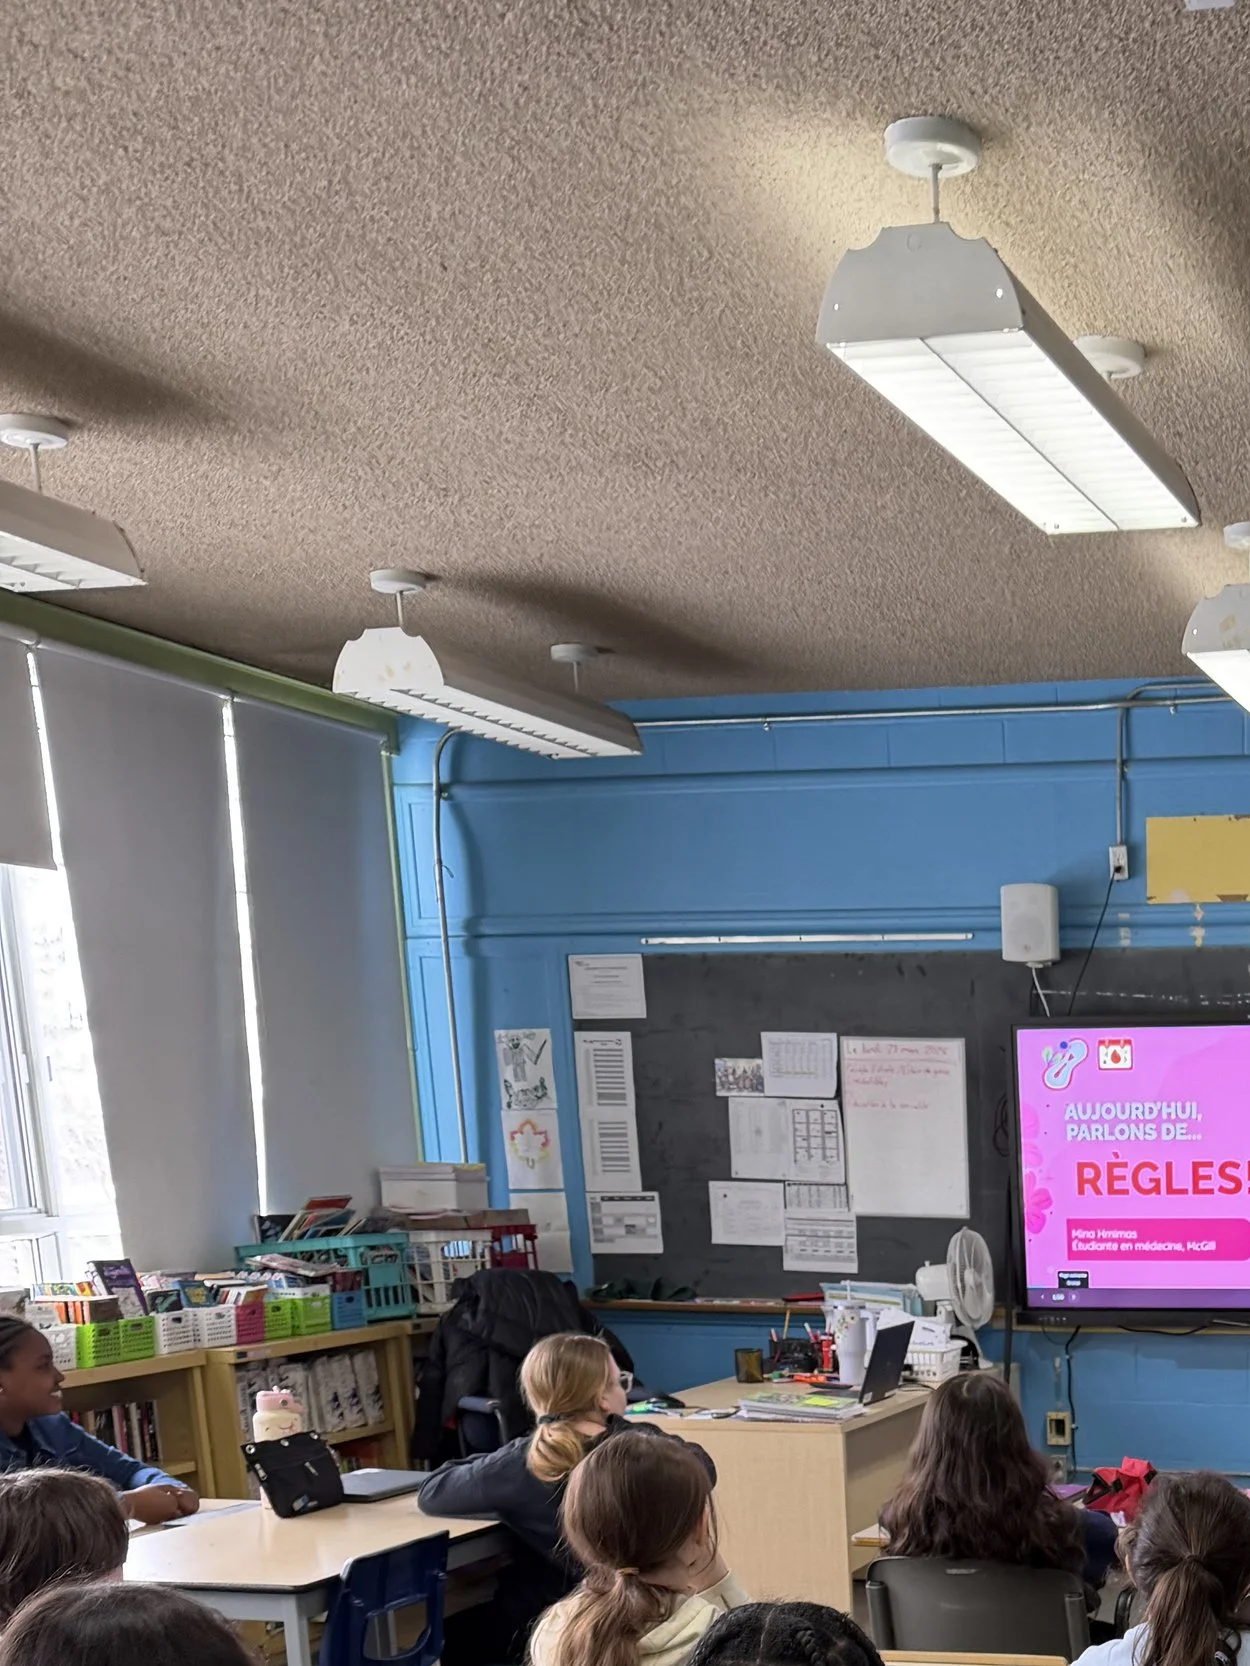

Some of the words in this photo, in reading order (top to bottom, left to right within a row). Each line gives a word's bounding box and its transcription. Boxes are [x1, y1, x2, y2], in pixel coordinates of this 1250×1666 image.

[1064, 1101, 1202, 1122] AUJOURD'HUI,
[1066, 1123, 1157, 1142] PARLONS
[1161, 1122, 1202, 1141] DE...
[1071, 1229, 1096, 1239] Mina
[1071, 1240, 1118, 1251] Étudiante
[1120, 1242, 1134, 1251] en
[1186, 1241, 1217, 1251] McGill
